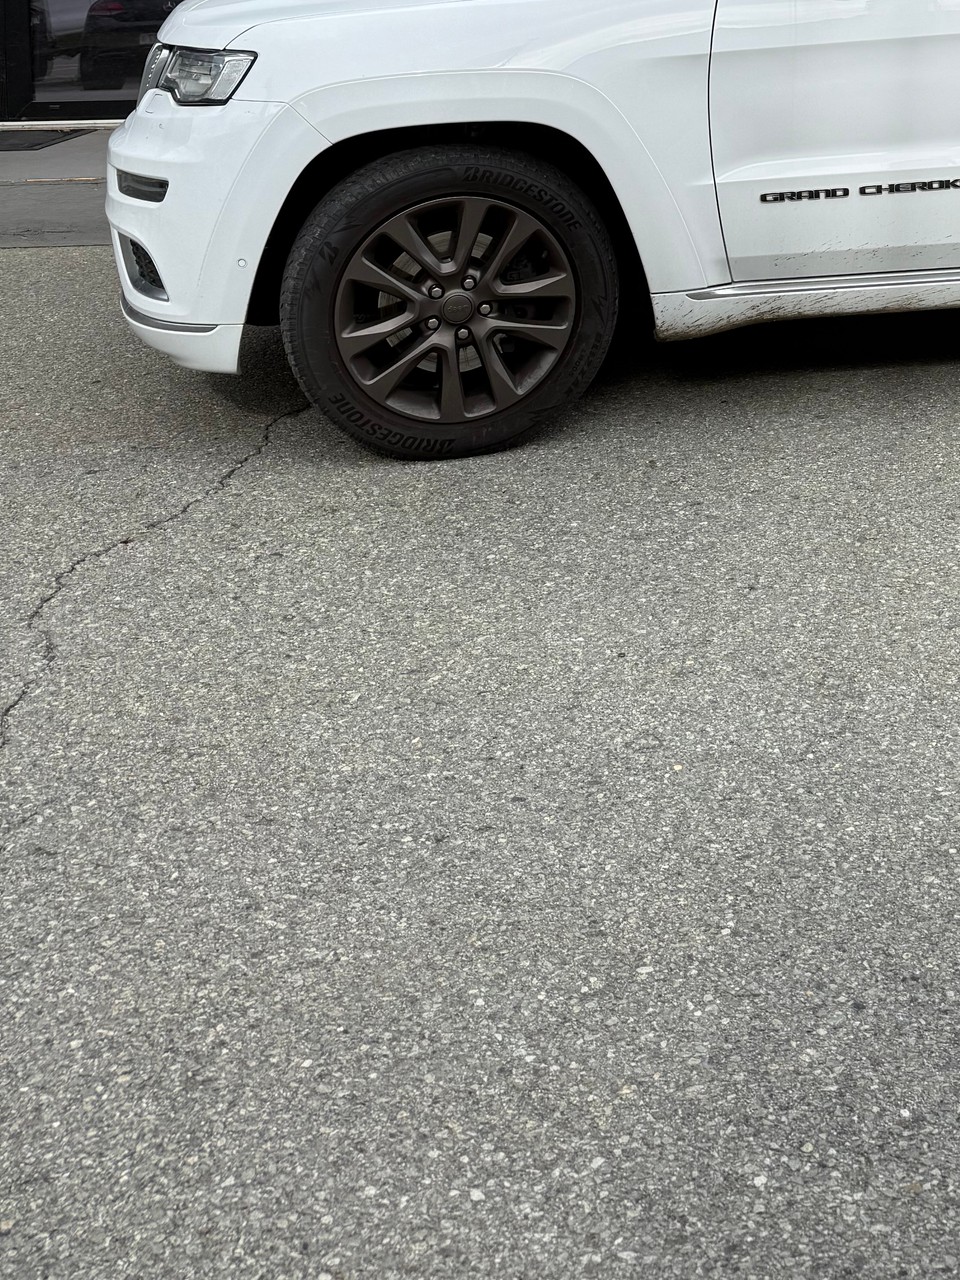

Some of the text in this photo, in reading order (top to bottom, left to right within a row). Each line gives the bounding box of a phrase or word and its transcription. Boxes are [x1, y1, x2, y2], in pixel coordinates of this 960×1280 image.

[462, 166, 582, 232] BRIDGESTONE
[760, 187, 850, 203] GRAND
[328, 392, 458, 454] BRIDGESTONE
